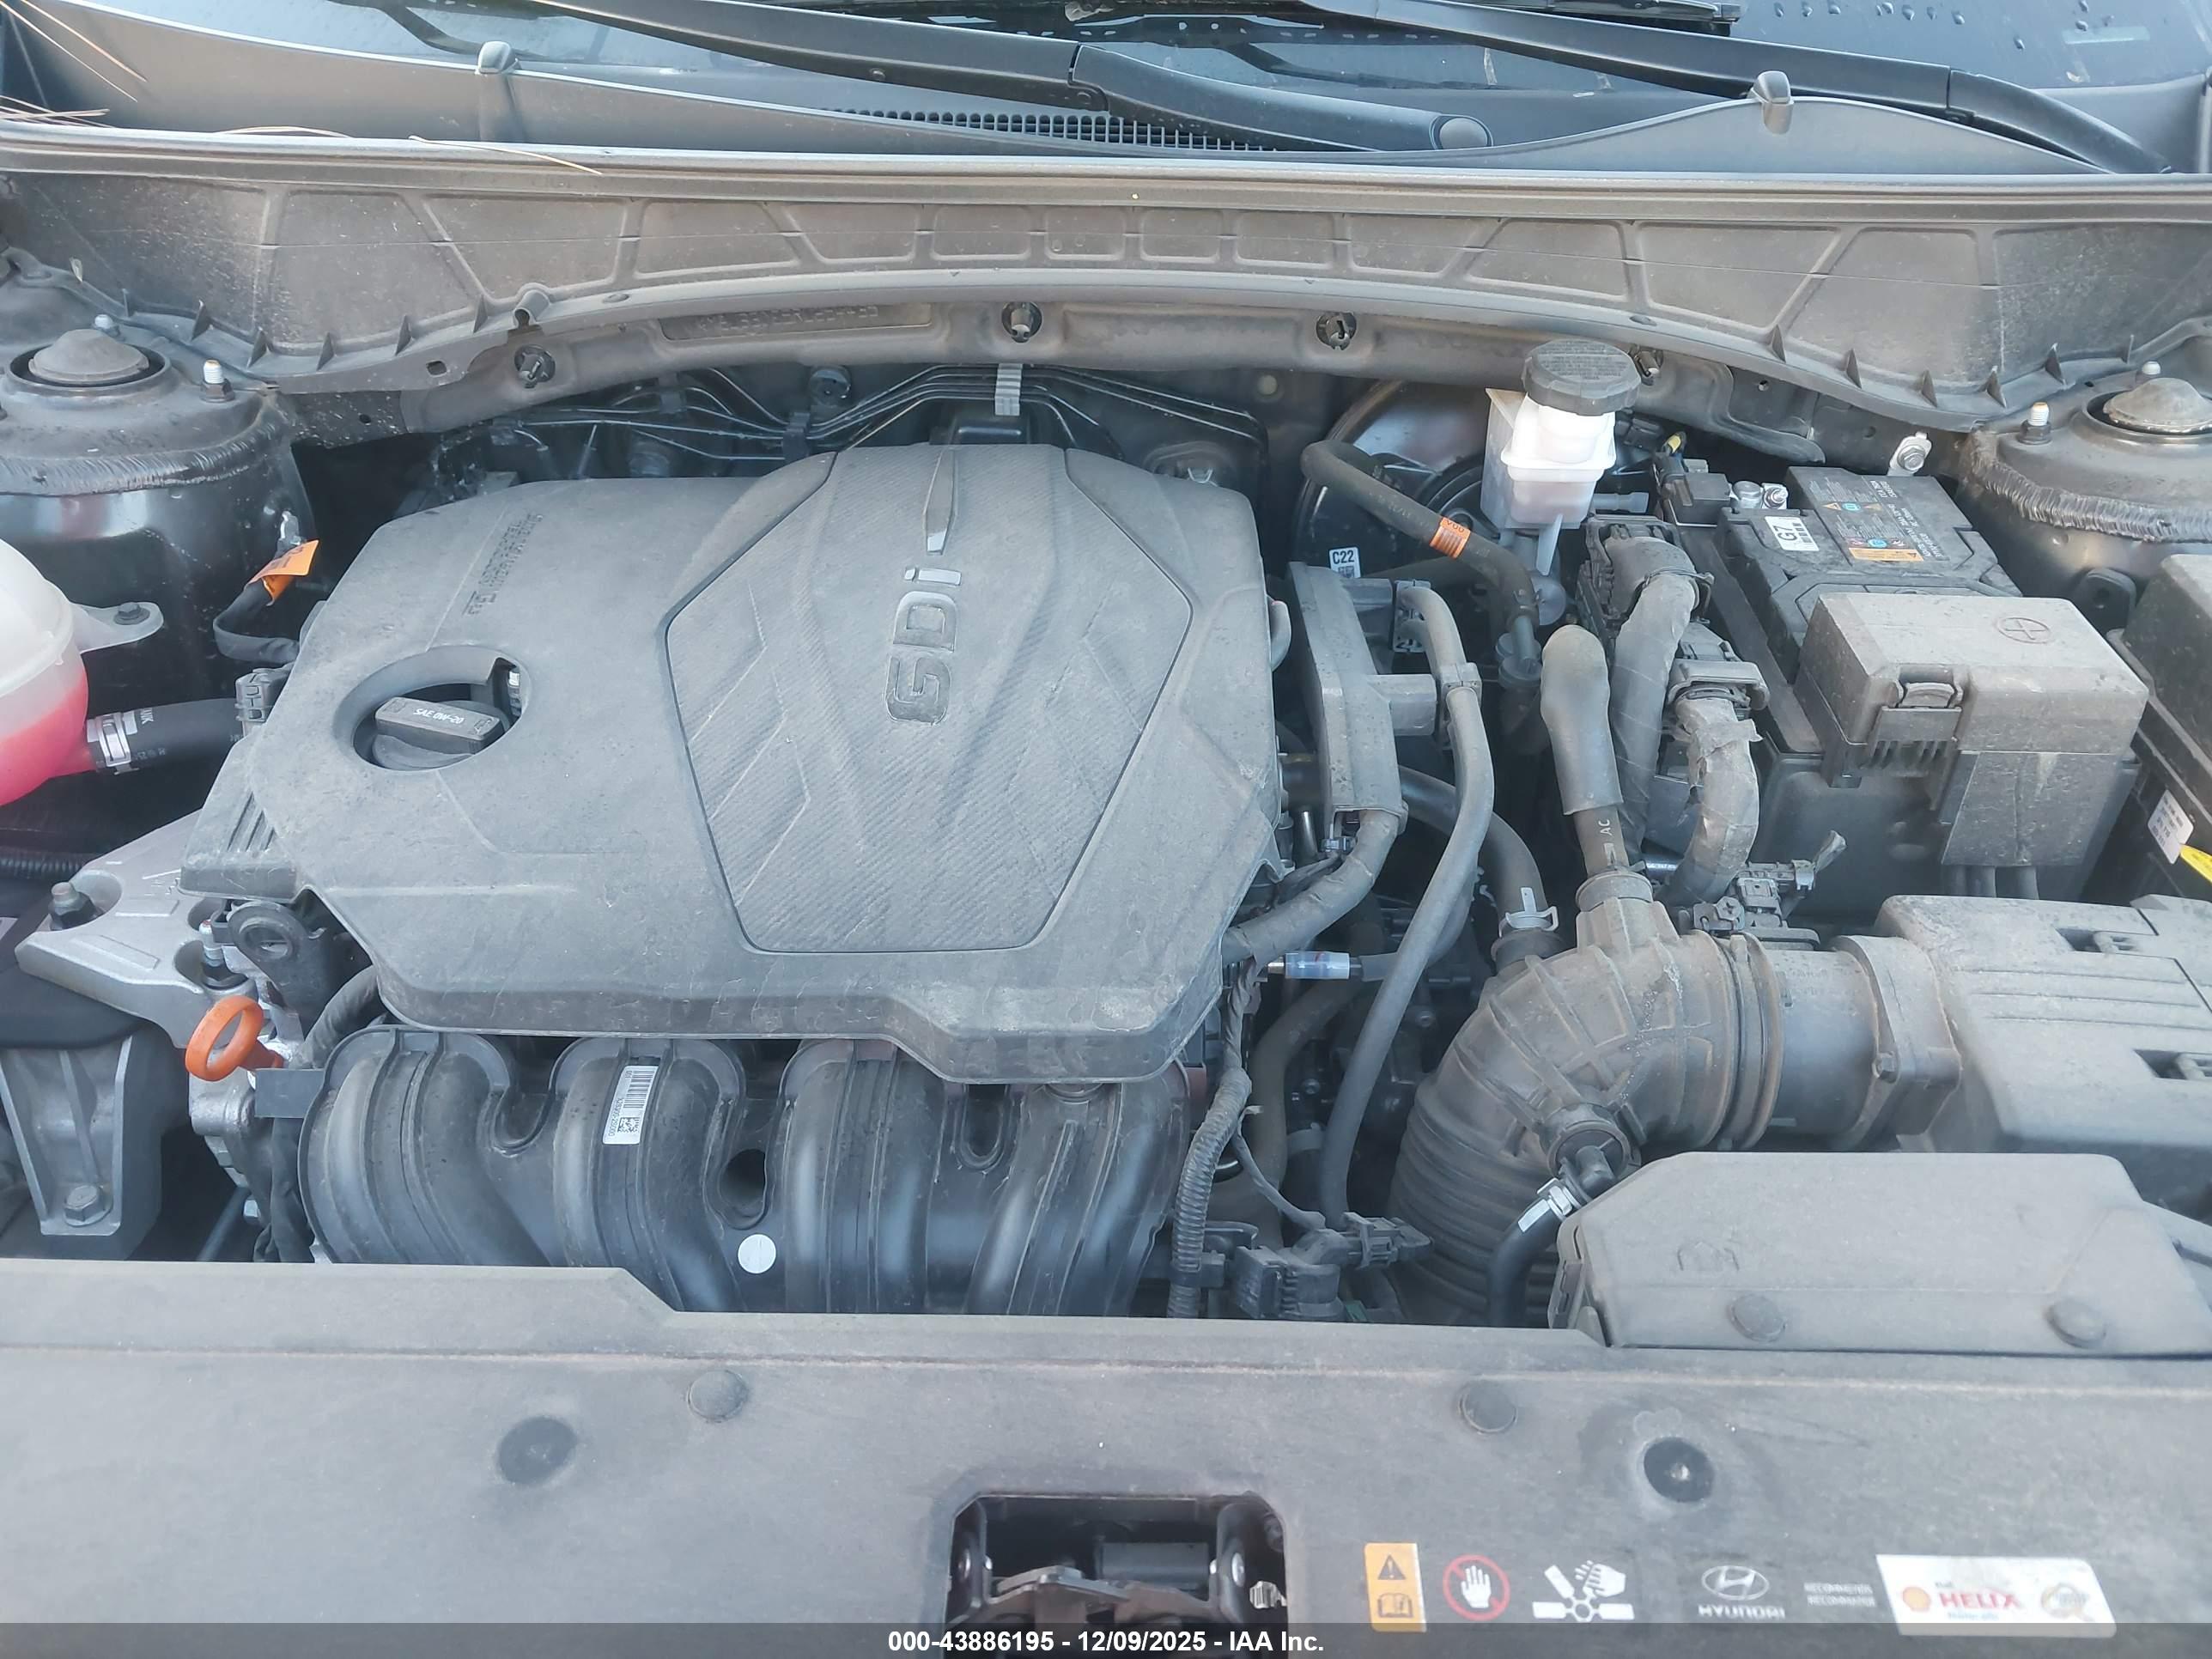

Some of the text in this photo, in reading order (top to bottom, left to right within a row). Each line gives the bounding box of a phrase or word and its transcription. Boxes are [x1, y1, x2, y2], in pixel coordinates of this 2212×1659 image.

[1771, 525, 1798, 541] G7
[1332, 550, 1354, 564] C22
[1598, 818, 1613, 836] AC
[1939, 1591, 2021, 1608] HELIX
[1698, 1604, 1785, 1620] HYUNDAI
